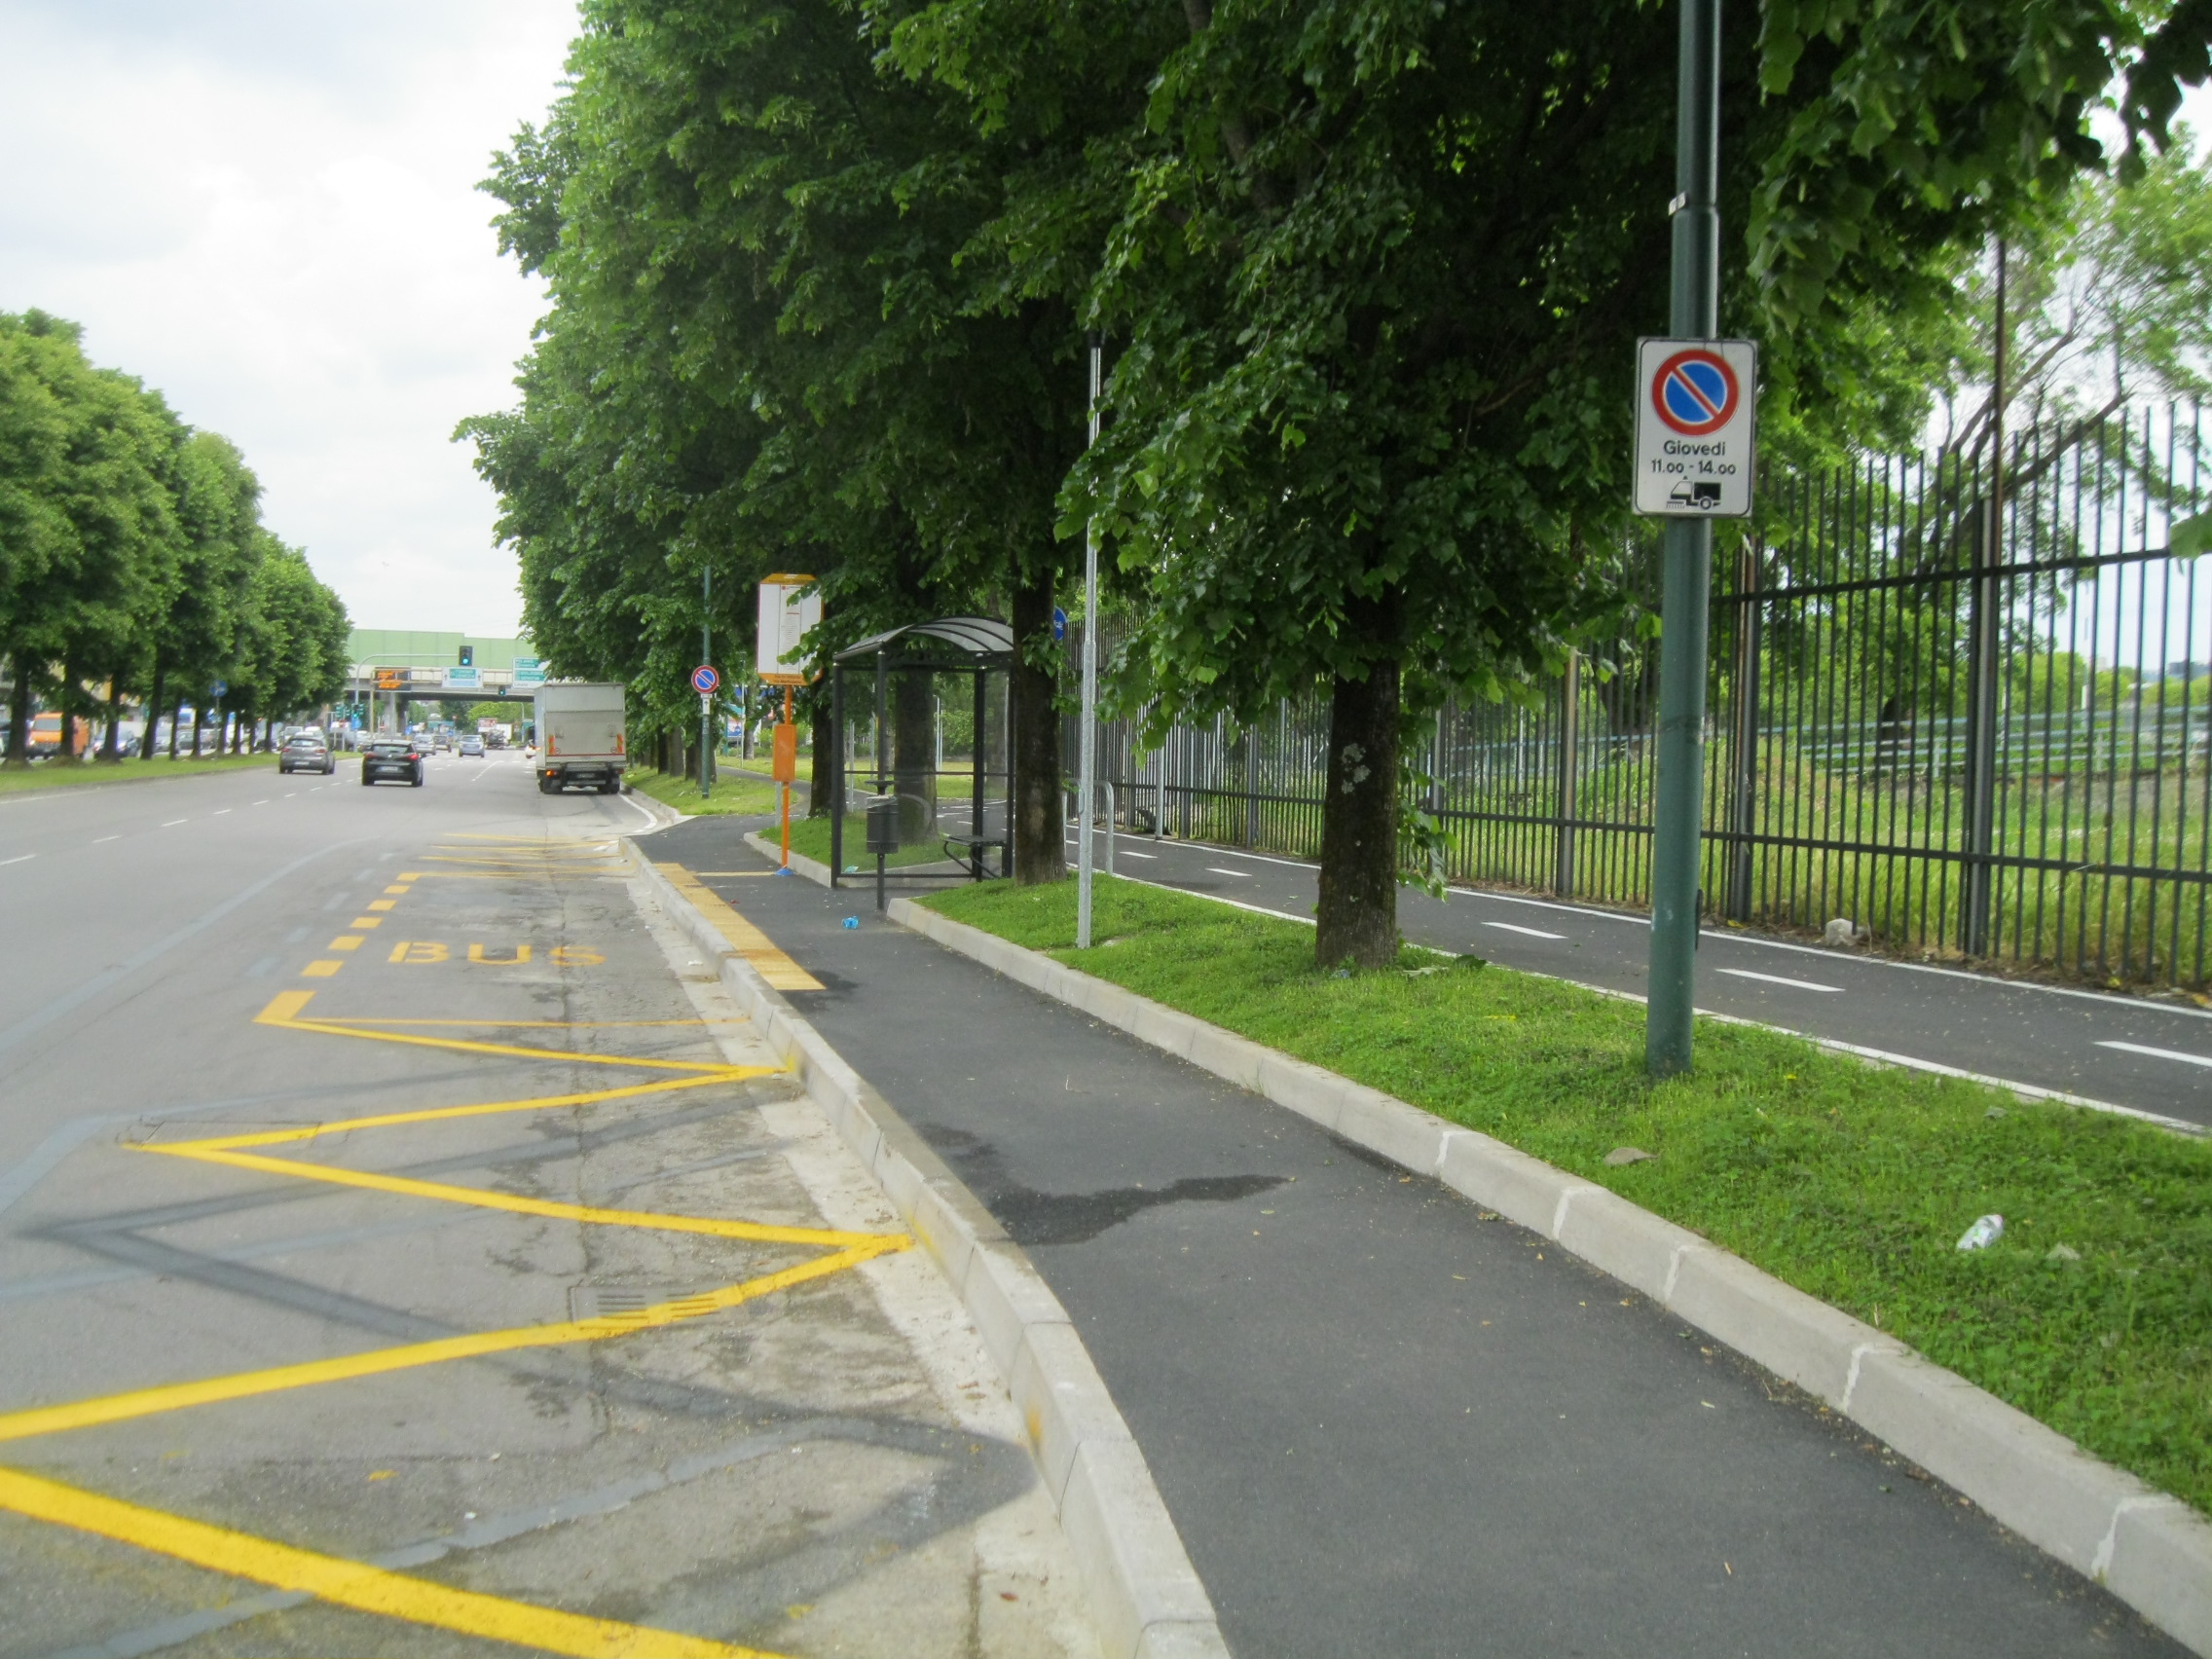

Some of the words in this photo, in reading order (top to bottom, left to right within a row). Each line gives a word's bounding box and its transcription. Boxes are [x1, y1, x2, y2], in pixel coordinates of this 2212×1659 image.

[1651, 459, 1684, 473] 11.00
[1698, 460, 1736, 475] 14.00
[387, 941, 608, 967] BUS
